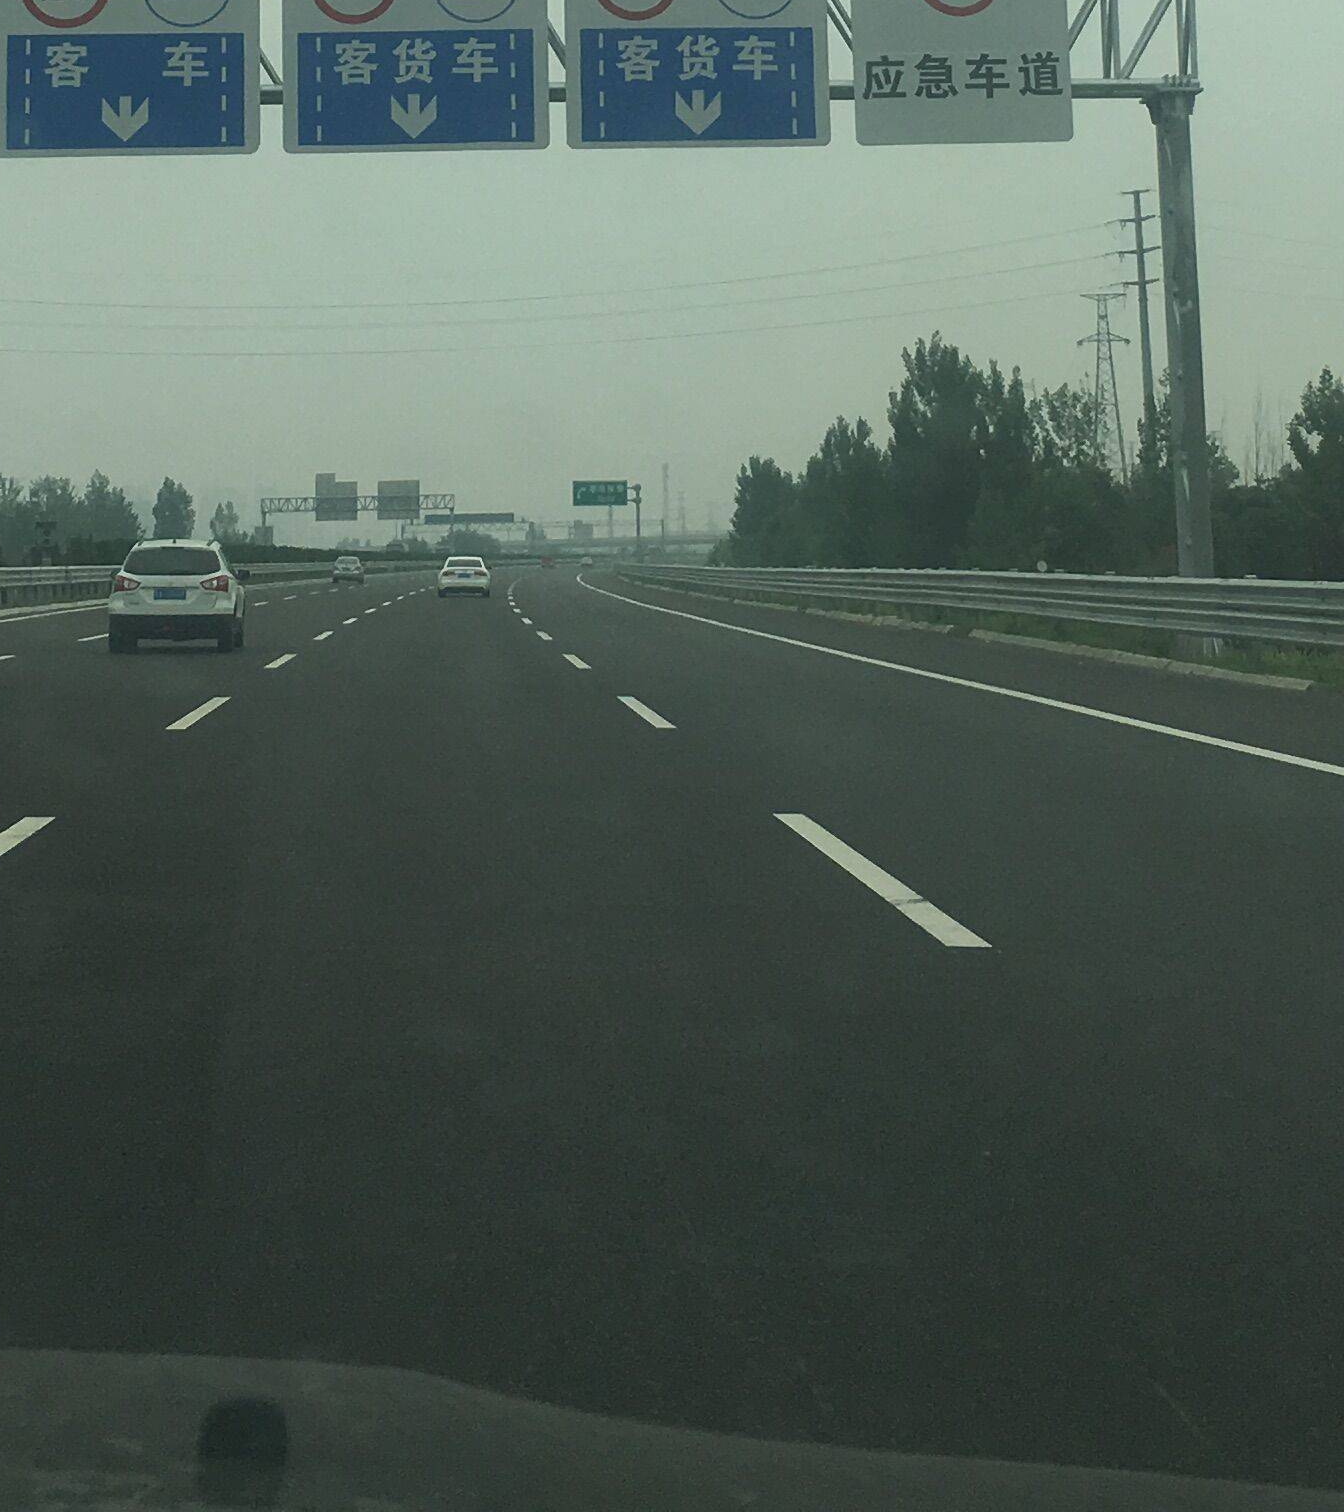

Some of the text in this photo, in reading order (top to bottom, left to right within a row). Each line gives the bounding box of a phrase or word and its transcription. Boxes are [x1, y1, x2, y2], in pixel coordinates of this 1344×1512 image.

[44, 41, 209, 87] 客车
[334, 37, 499, 86] 客货车
[616, 34, 779, 82] 客货车
[863, 51, 1063, 101] 应急车道
